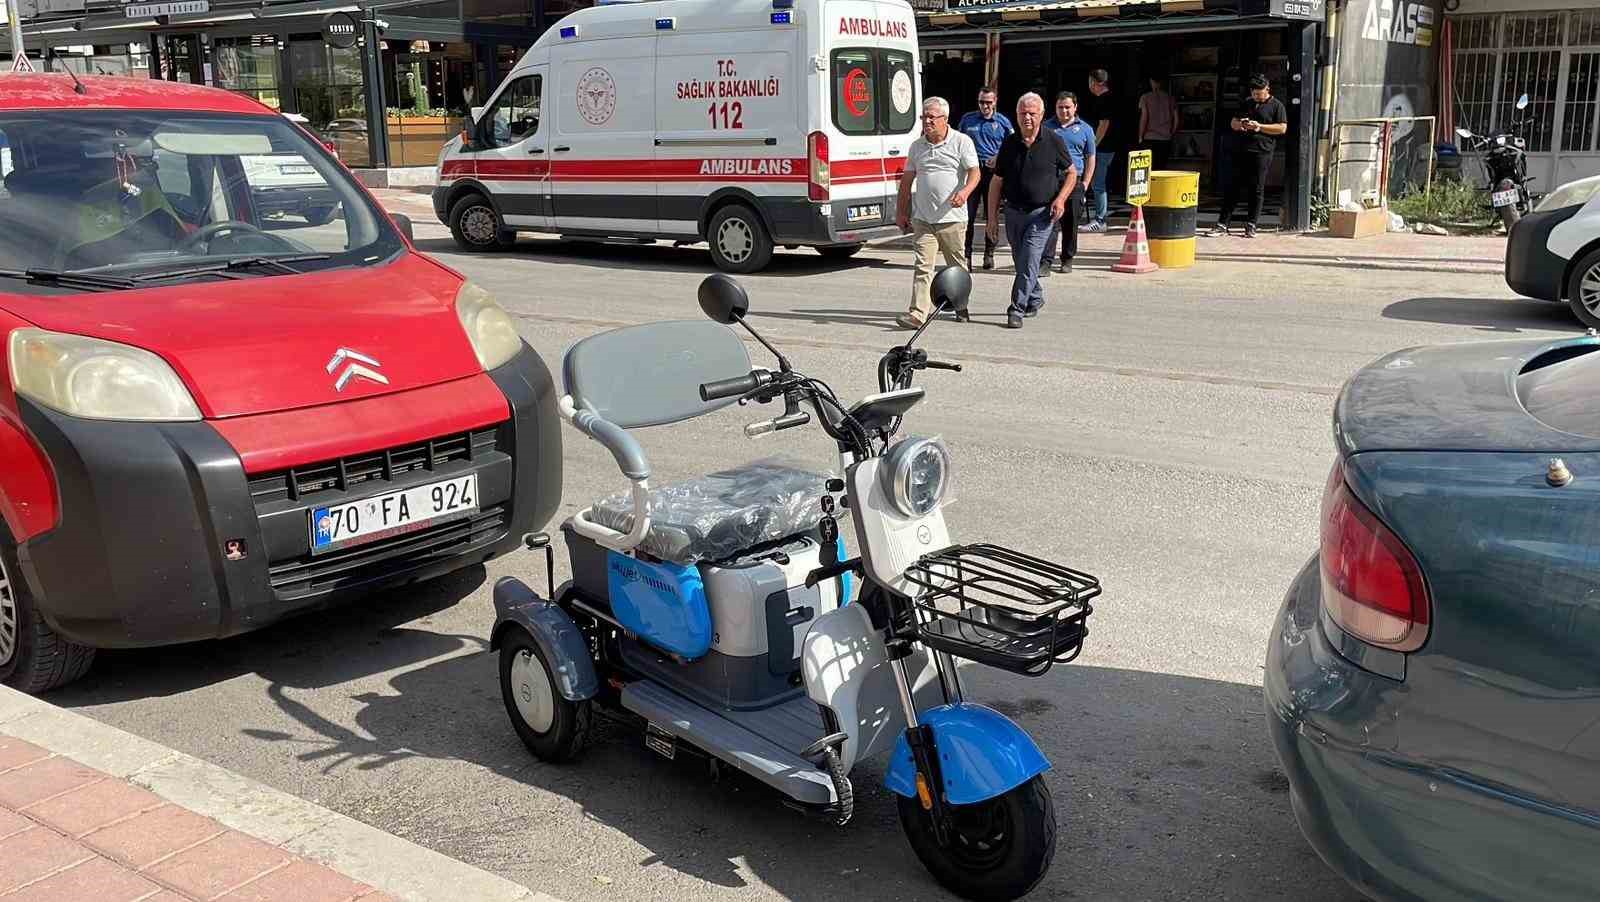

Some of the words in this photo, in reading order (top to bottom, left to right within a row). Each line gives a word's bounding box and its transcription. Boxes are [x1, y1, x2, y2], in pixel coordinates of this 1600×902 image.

[839, 17, 908, 38] AMBULANS
[1362, 0, 1418, 44] ARAS
[717, 60, 737, 77] T.C.
[677, 79, 716, 99] SAĞLIK
[719, 75, 779, 98] BAKANLIĞI
[708, 101, 743, 129] 112
[700, 159, 793, 175] AMBULANS
[1130, 156, 1150, 169] ARAS
[330, 507, 360, 539] 70
[381, 493, 411, 526] FA
[431, 479, 473, 513] 924
